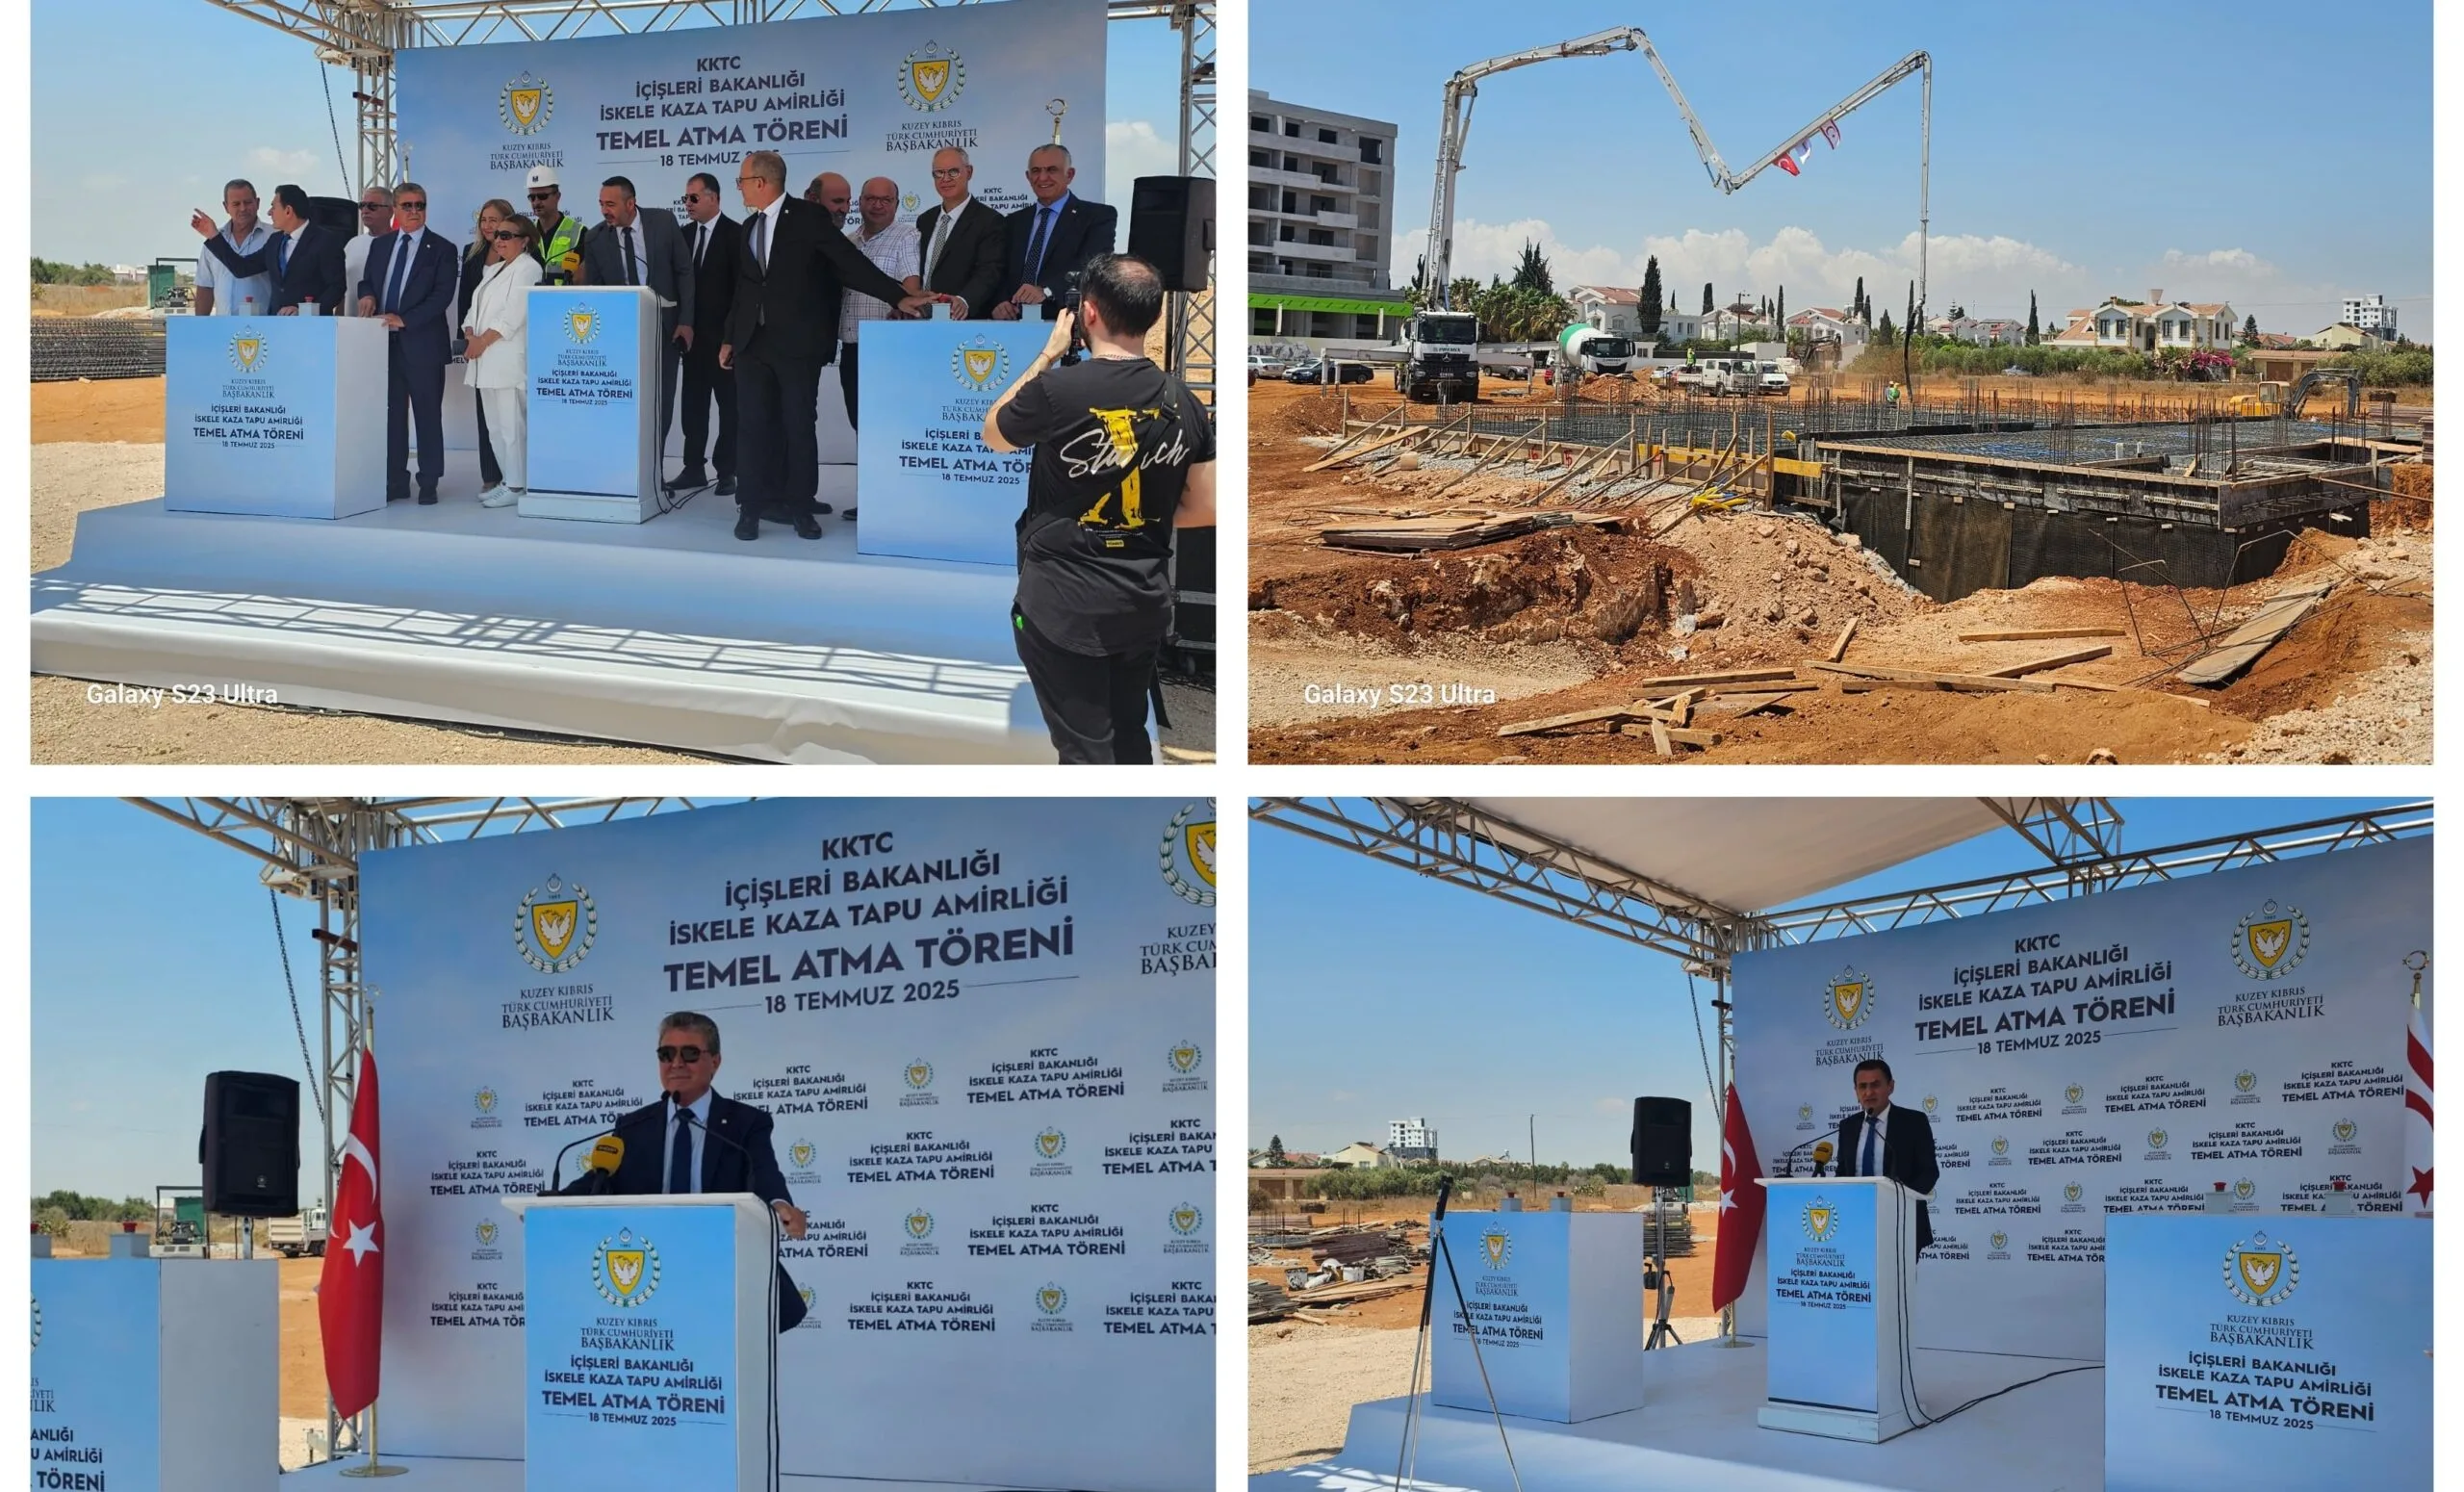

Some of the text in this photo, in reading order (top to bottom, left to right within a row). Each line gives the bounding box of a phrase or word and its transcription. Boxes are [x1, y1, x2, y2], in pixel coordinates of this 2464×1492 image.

[697, 56, 740, 72] KKTC
[636, 70, 805, 100] İÇİŞLERİ BAKANLIĞI
[601, 89, 844, 120] İSKELE KAZA TAPU AMİRLİĞİ
[597, 114, 848, 150] TEMEL ATMA TÖRENİ
[902, 121, 931, 130] KUZEY
[912, 128, 977, 140] CUMHURİYETİ
[886, 138, 978, 153] BAŞBAKANLIK
[490, 158, 564, 171] BAŞBAKANLIK
[660, 154, 673, 167] 18
[679, 151, 740, 166] TEMMUZ
[222, 391, 274, 399] BAŞBAKANLIK
[598, 388, 632, 399] TÖRENİ
[212, 403, 286, 415] İÇİŞLERİ BAKANLIĞI
[194, 414, 219, 423] İSKELE
[245, 416, 266, 424] TAPU
[268, 416, 302, 425] AMİRLİĞİ
[193, 427, 304, 440] TEMEL ATMA TÖRENİ
[925, 428, 969, 441] İÇİŞLERİ
[902, 442, 972, 452] İSKELE KAZA
[899, 456, 997, 472] TEMEL ATMA
[954, 475, 994, 483] TEMMUZ
[822, 831, 893, 861] KKTC
[725, 848, 1000, 912] İÇİŞLERİ BAKANLIĞI
[670, 875, 1067, 946] İSKELE KAZA TAPU AMİRLİĞİ
[1168, 923, 1217, 939] KUZEY
[1140, 942, 1182, 957] TÜRK
[2015, 934, 2061, 954] KKTC
[663, 914, 1074, 992] TEMEL ATMA TÖRENİ
[1954, 943, 2128, 988] İÇİŞLERİ BAKANLIĞI
[521, 984, 594, 999] KUZEY KIBRIS
[1919, 961, 2171, 1011] İSKELE KAZA TAPU AMİRLİĞİ
[765, 979, 960, 1016] 18 TEMMUZ 2025
[2235, 987, 2305, 1002] KUZEY KIBRIS
[501, 994, 612, 1014] TÜRK CUMHURİYETİ
[2218, 994, 2323, 1015] TÜRK CUMHURİYETİ
[502, 1007, 614, 1031] BAŞBAKANLIK
[1915, 988, 2175, 1042] TEMEL ATMA TÖRENİ
[2218, 1005, 2325, 1027] BAŞBAKANLIK
[1827, 1036, 1871, 1046] KUZEY KIBRIS
[1979, 1030, 2101, 1055] 18 TEMMUZ 2025
[1030, 1048, 1058, 1058] KKTC
[1816, 1051, 1885, 1067] BAŞBAKANLIK
[991, 1057, 1098, 1073] İÇİŞLERİ BAKANLIĞI
[969, 1067, 1122, 1087] İSKELE KAZA TAPU AMİRLİĞİ
[2301, 1067, 2384, 1080] İÇİŞLERİ BAKANLIĞI
[2364, 1074, 2402, 1084] AMİRLİĞİ
[967, 1081, 1125, 1104] TEMEL ATMA TÖRENİ
[2282, 1085, 2404, 1102] TEMEL ATMA TÖRENİ
[1776, 1289, 1871, 1302] TEMEL ATMA TÖRENİ
[597, 1317, 657, 1327] KUZEY KIBRIS
[2227, 1314, 2295, 1326] KUZEY KIBRIS
[581, 1327, 674, 1339] TÜRK CUMHURİYETİ
[1482, 1326, 1543, 1340] ATMA TÖRENİ
[2210, 1324, 2313, 1338] TÜRK CUMHURİYETİ
[581, 1337, 675, 1351] BAŞBAKANLIK
[2210, 1331, 2314, 1350] BAŞBAKANLIK
[571, 1355, 693, 1372] İÇİŞLERİ BAKANLIĞI
[2189, 1351, 2336, 1376] İÇİŞLERİ BAKANLIĞI
[545, 1370, 722, 1390] İSKELE KAZA TAPU AMİRLİĞİ
[2159, 1364, 2372, 1396] İSKELE KAZA TAPU AMİRLİĞİ
[542, 1390, 725, 1414] TEMEL ATMA TÖRENİ
[2156, 1384, 2374, 1422] TEMEL ATMA TÖRENİ
[590, 1413, 677, 1426] 18 TEMMUZ 2025
[2210, 1409, 2314, 1430] 18 TEMMUZ 2025
[44, 1447, 102, 1463] AMİRLİĞİ
[37, 1468, 105, 1492] TÖRENİ
